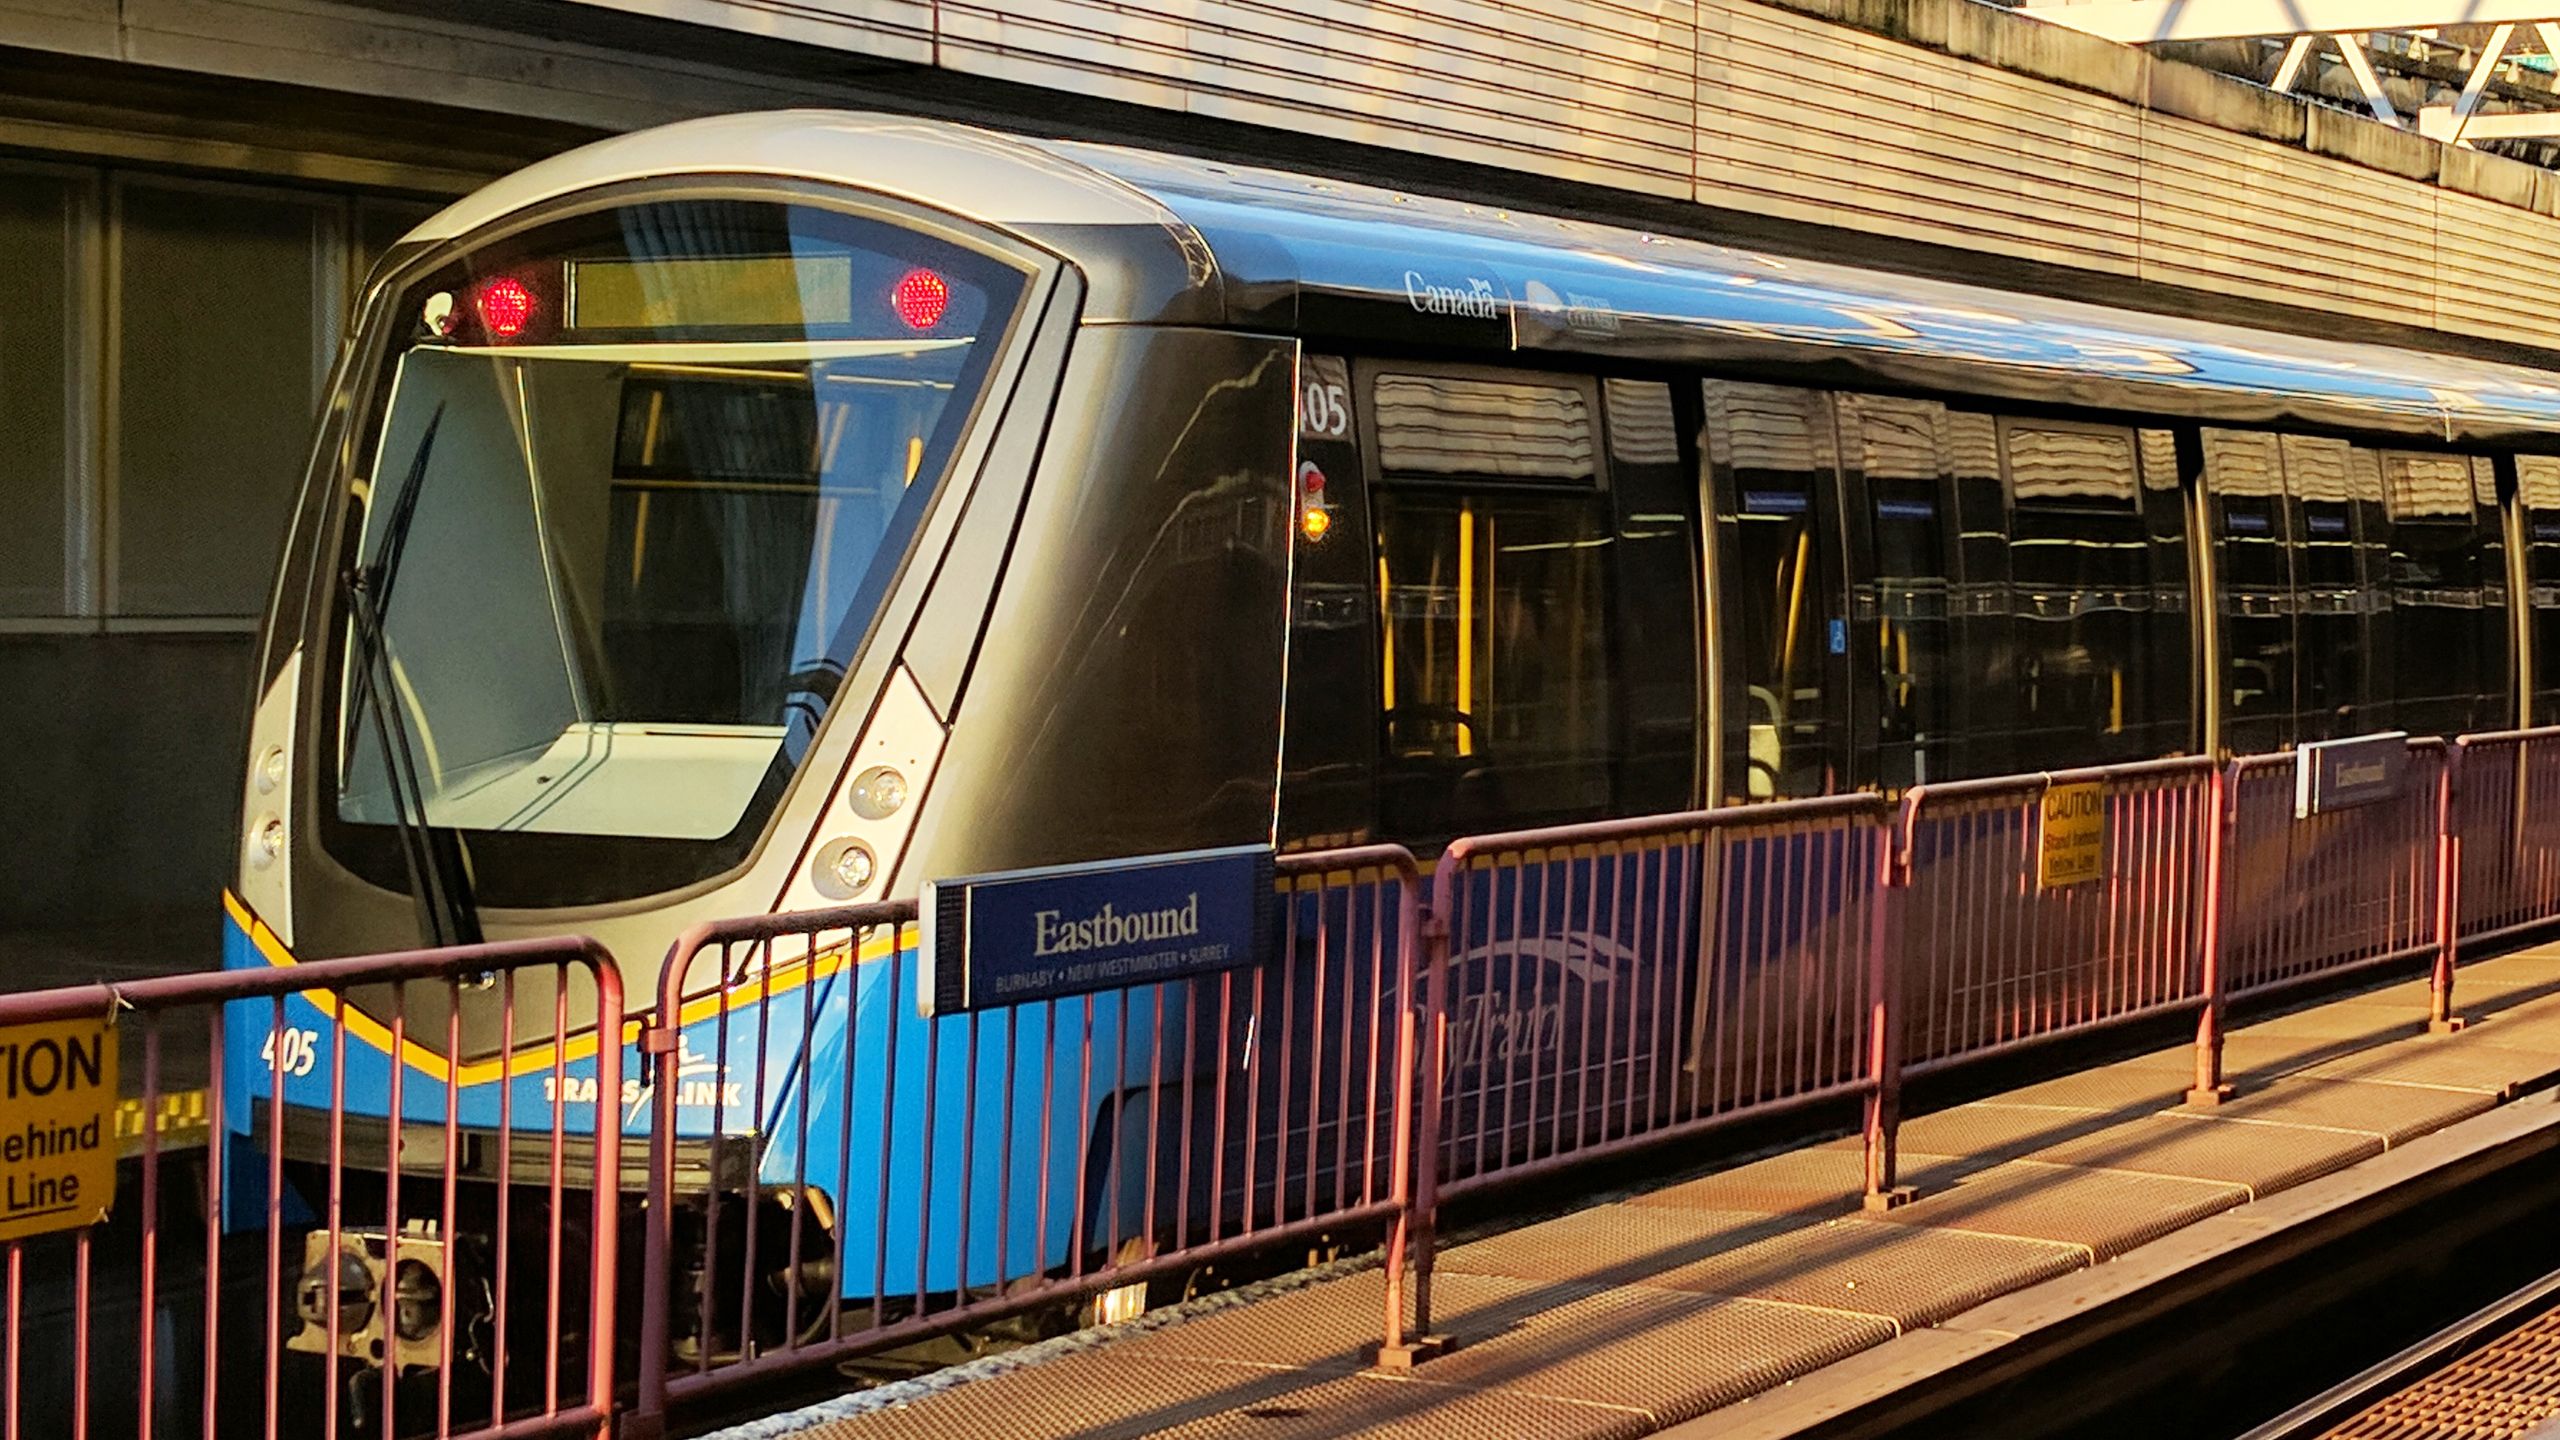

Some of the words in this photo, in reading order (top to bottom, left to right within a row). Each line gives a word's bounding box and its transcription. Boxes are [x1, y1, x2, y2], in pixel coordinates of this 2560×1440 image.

[1404, 271, 1498, 320] Canada
[2047, 790, 2101, 821] CAUTION
[1034, 891, 1198, 957] Eastbound
[995, 969, 1056, 994] BURNABY
[1066, 962, 1098, 982] NEW
[1099, 951, 1179, 979] WESTMINSTER
[1188, 943, 1231, 966] SURREY
[0, 1032, 101, 1099] ION
[261, 1027, 318, 1076] 405
[7, 1173, 79, 1211] Line
